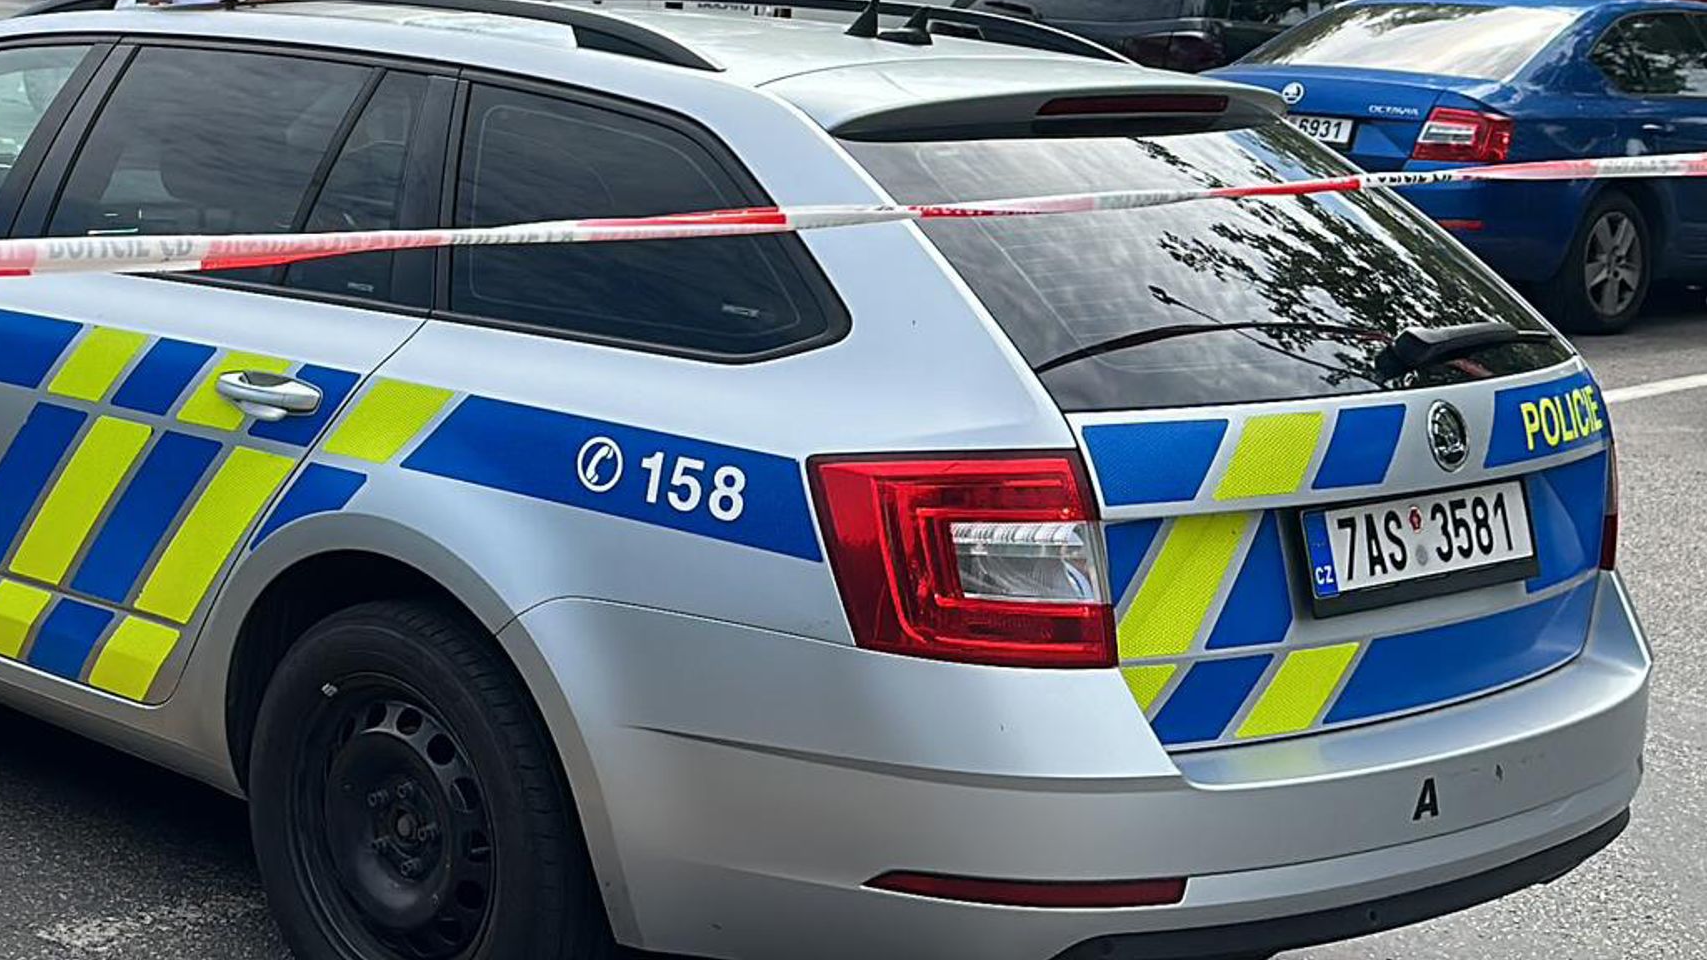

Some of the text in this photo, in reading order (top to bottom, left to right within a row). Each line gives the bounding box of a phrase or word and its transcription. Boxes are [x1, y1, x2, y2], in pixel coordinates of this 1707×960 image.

[1520, 385, 1603, 450] POLICIE
[641, 451, 746, 522] 158
[1336, 492, 1514, 581] 7AS 3581
[1315, 566, 1335, 585] CZ
[1412, 777, 1440, 821] A
